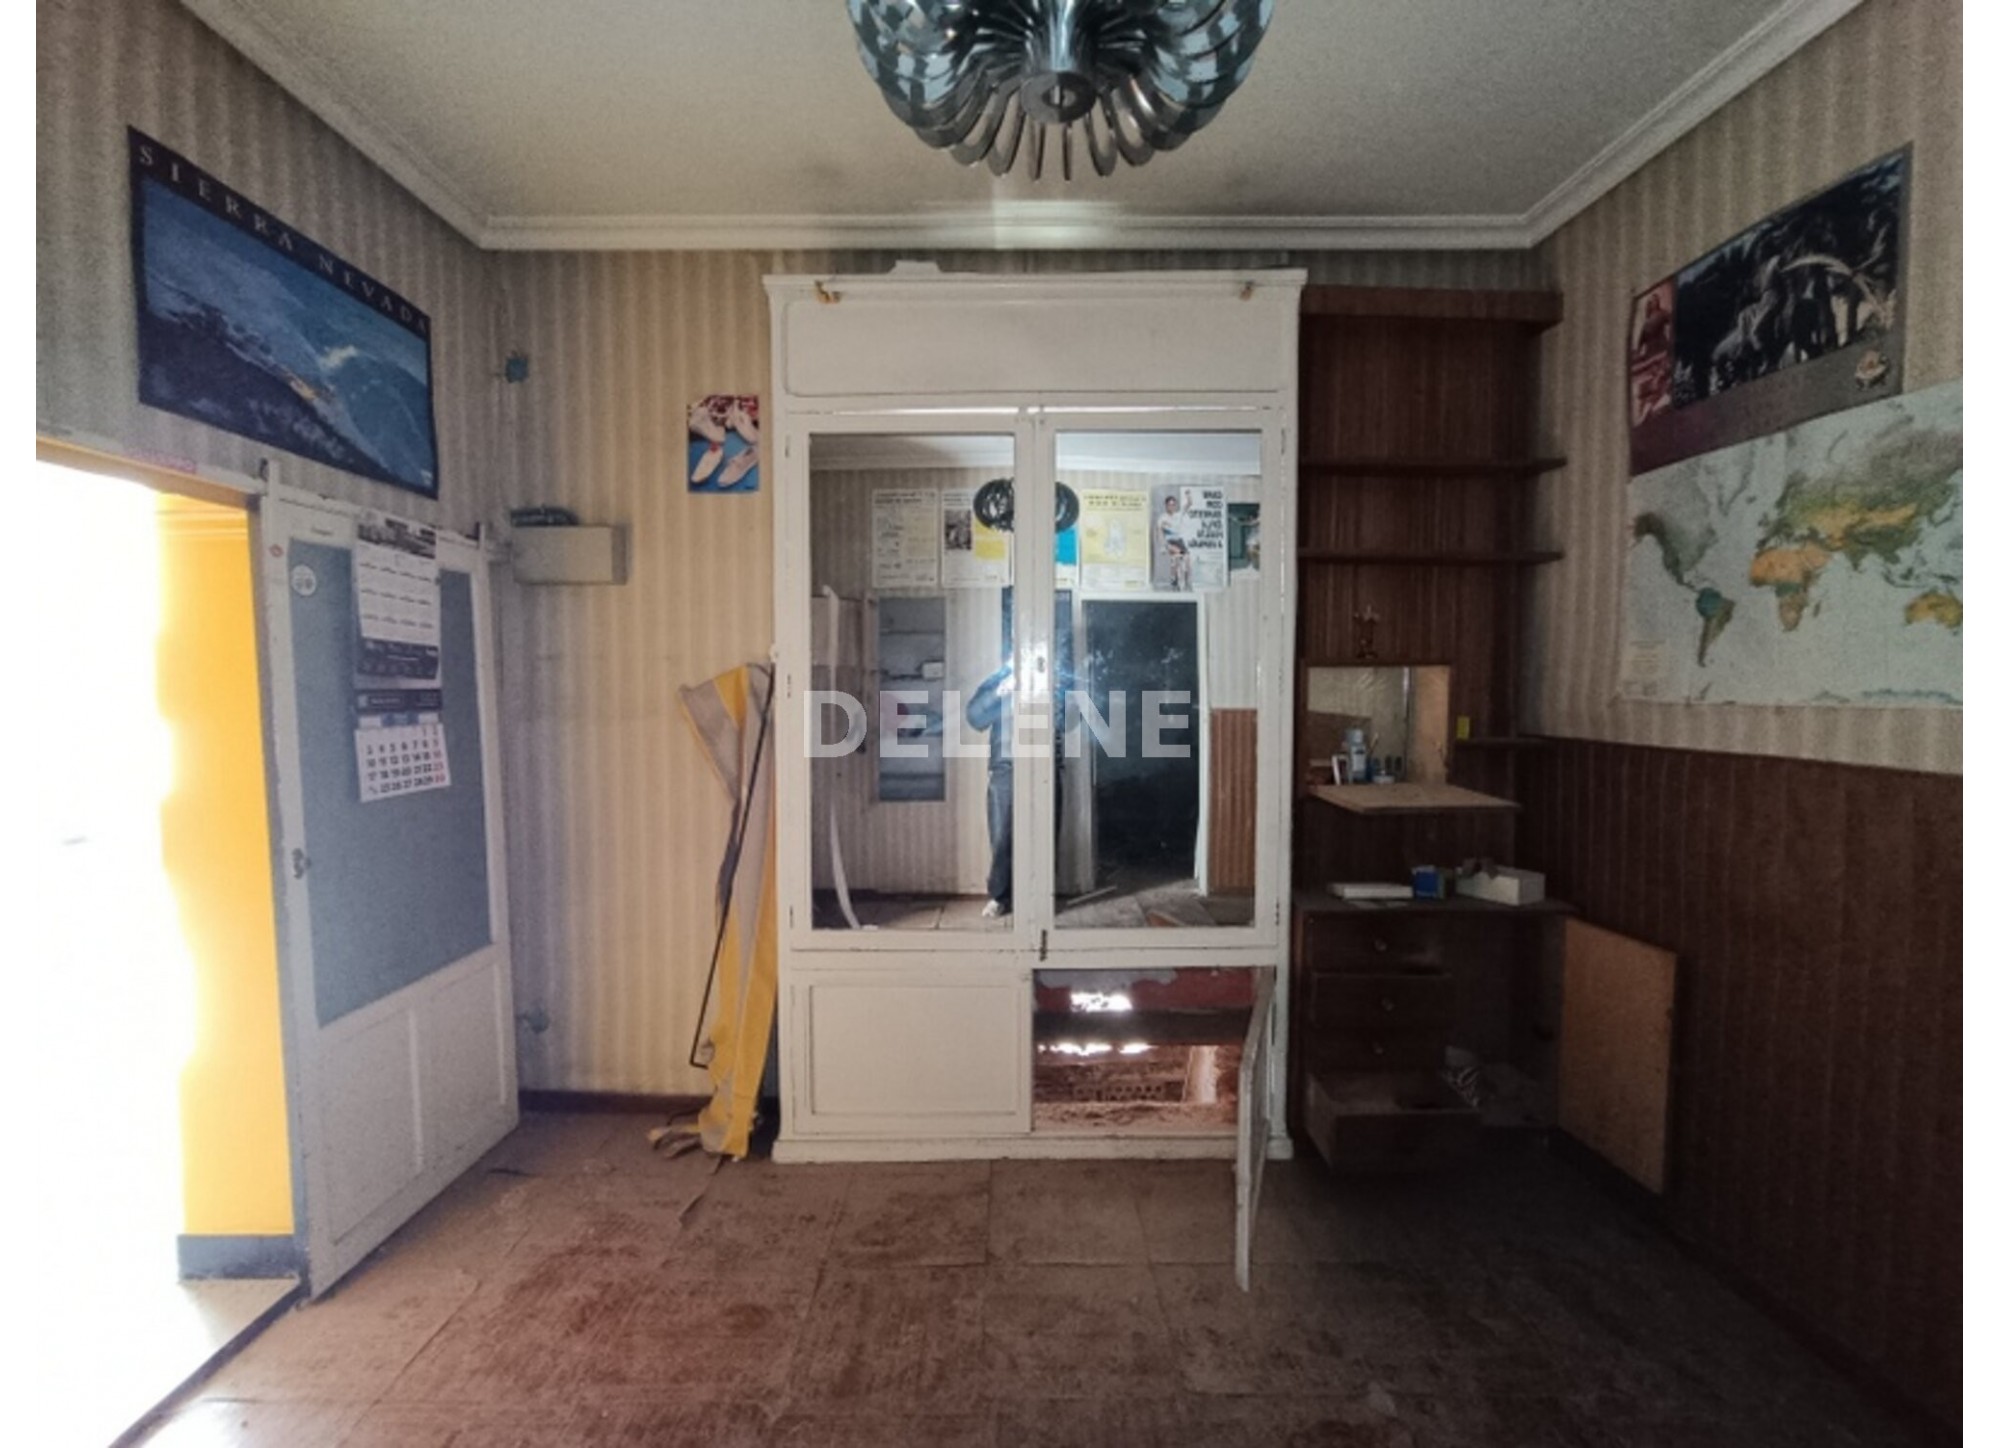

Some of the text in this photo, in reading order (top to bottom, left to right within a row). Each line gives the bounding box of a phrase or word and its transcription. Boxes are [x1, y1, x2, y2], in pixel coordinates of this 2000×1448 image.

[139, 145, 428, 332] SIERRA NEVADA
[390, 743, 396, 752] 5
[413, 740, 418, 750] 7
[390, 756, 399, 765] 12
[402, 754, 410, 764] 13
[413, 753, 421, 761] 14
[380, 770, 389, 779] 18
[391, 769, 400, 777] 19
[402, 767, 412, 776] 20
[423, 763, 432, 773] 22
[404, 780, 412, 789] 27
[435, 774, 446, 783] 30
